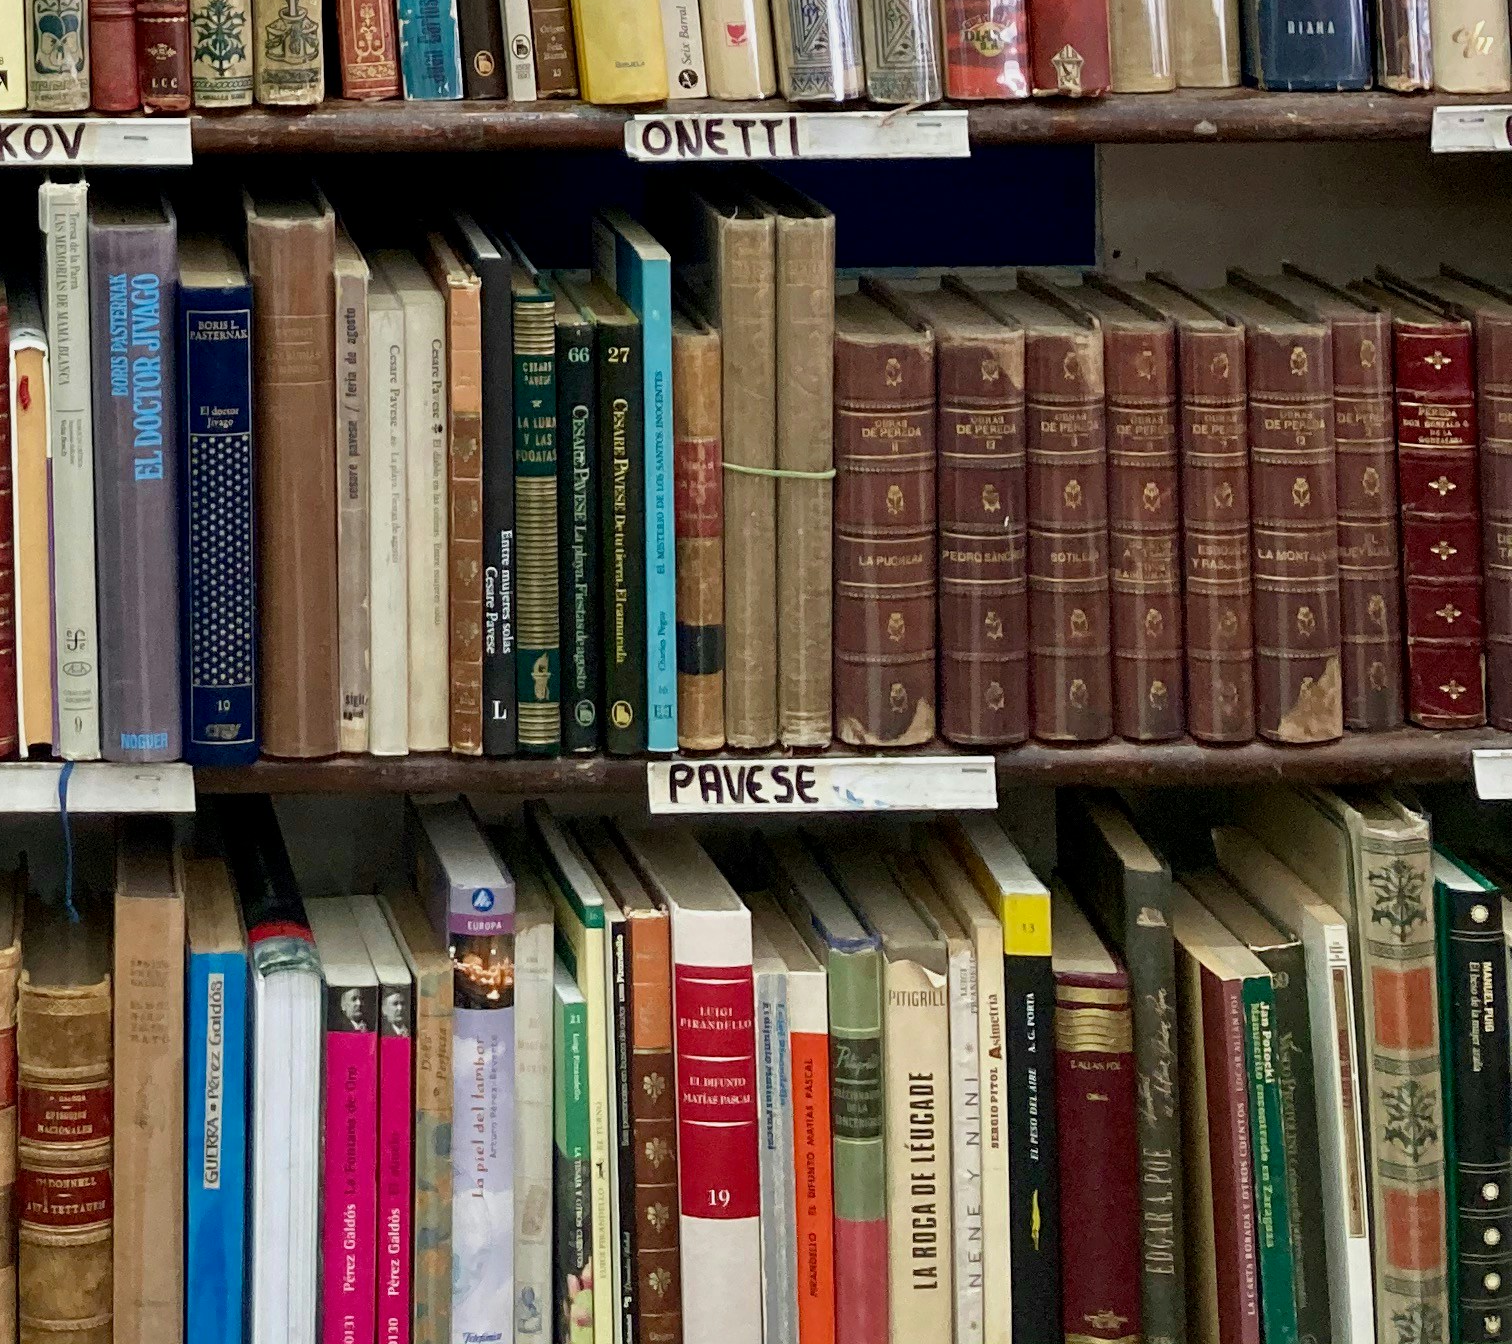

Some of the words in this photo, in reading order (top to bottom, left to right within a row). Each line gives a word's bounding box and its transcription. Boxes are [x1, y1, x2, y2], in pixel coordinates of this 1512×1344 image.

[642, 118, 800, 156] ONETTI
[109, 272, 128, 355] PASTERNAK
[131, 272, 160, 352] JIVAGO
[567, 347, 590, 362] 66
[608, 346, 630, 363] 27
[110, 356, 129, 397] BORIS
[132, 354, 161, 447] DOCTOR
[134, 449, 162, 480] EL
[669, 765, 819, 803] PAVESE
[707, 1188, 730, 1206] 19
[910, 1172, 936, 1196] DE
[911, 1202, 937, 1259] ROCA
[913, 1265, 938, 1290] LA
